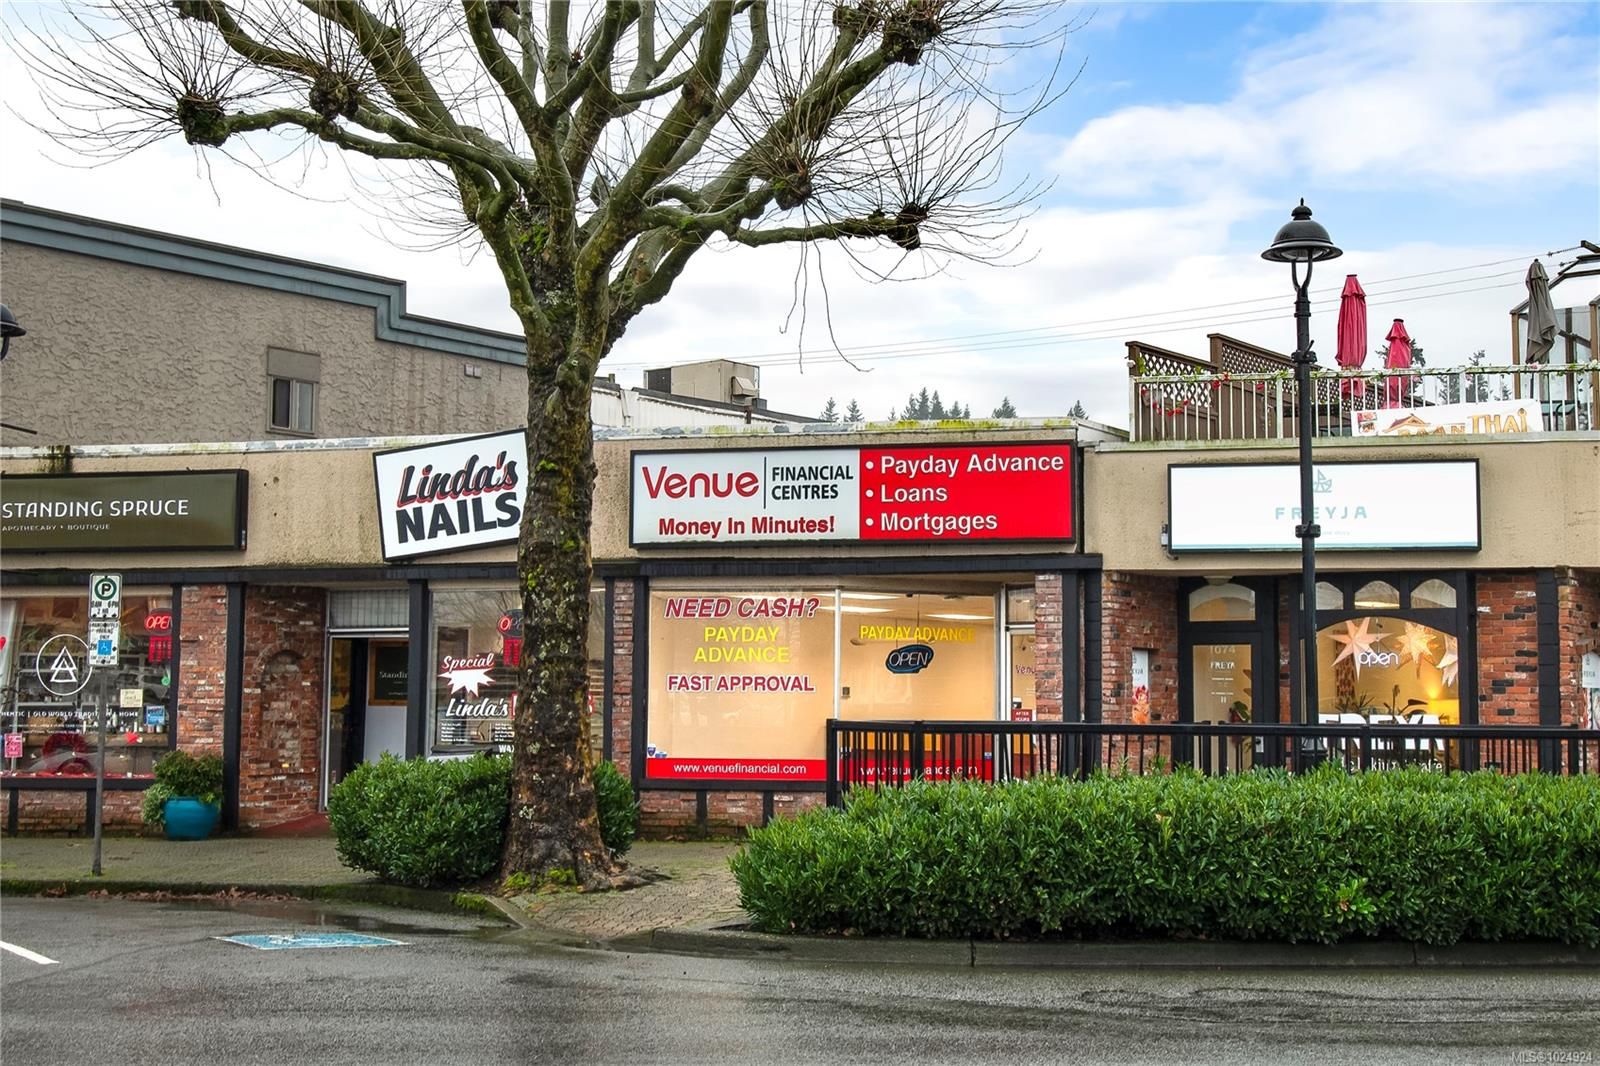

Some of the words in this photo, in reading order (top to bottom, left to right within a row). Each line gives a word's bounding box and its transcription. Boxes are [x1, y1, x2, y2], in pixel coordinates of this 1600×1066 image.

[1468, 408, 1528, 434] THAI
[771, 465, 854, 482] FINANCIAL
[881, 455, 959, 478] Payday
[967, 454, 1064, 472] Advance
[396, 450, 519, 508] Linda's
[642, 466, 760, 499] Venue
[771, 484, 839, 501] CENTRES
[881, 484, 948, 503] Loans
[2, 501, 103, 519] STANDING
[110, 499, 190, 517] SPRUCE
[395, 491, 521, 544] NAILS
[2, 524, 57, 532] APOTHECARY
[67, 523, 111, 531] BOUTIQUE
[658, 517, 722, 539] Money
[728, 517, 745, 534] In
[751, 516, 836, 534] Minutes!
[881, 512, 998, 535] Mortgages
[665, 598, 731, 618] NEED
[737, 597, 820, 618] CASH?
[704, 626, 780, 643] PAYDAY
[860, 625, 911, 640] PAYDAY
[915, 626, 976, 641] ADVANCE
[442, 653, 495, 673] Special
[693, 647, 790, 663] ADVANCE
[888, 651, 929, 666] OPEN
[1359, 652, 1399, 668] open
[668, 675, 713, 691] FAST
[716, 675, 815, 691] APPROVAL
[446, 698, 509, 717] Linda's
[673, 762, 807, 775] www.venuefinancial.com
